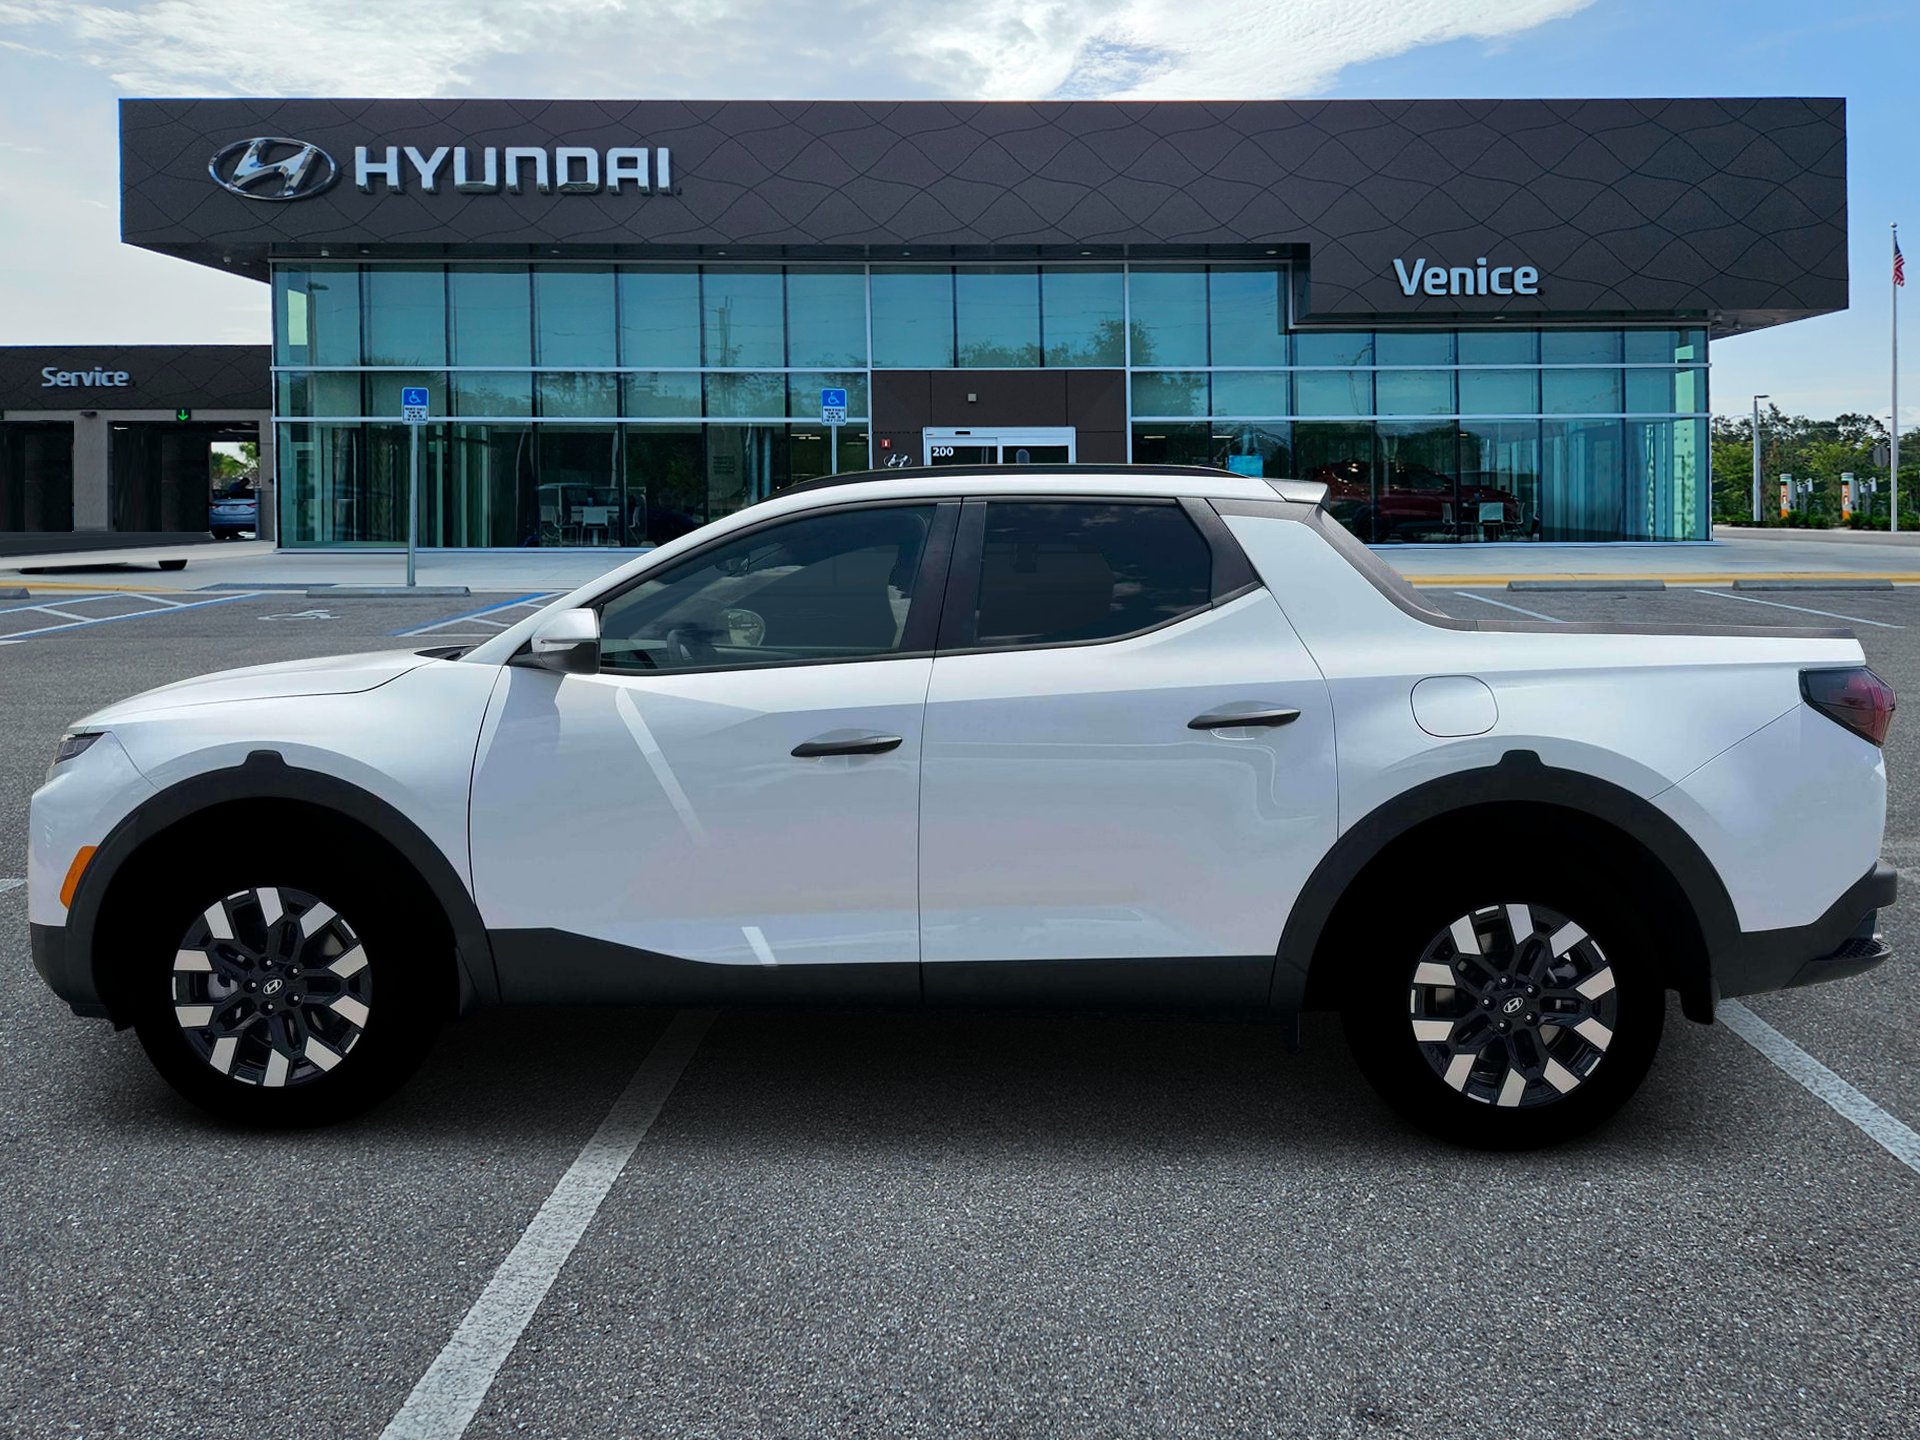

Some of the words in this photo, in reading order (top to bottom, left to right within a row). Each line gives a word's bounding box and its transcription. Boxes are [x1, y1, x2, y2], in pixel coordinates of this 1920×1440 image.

[354, 146, 671, 194] HYUNDAI
[1393, 257, 1539, 296] Venice
[41, 366, 130, 387] Service
[932, 447, 954, 457] 200
